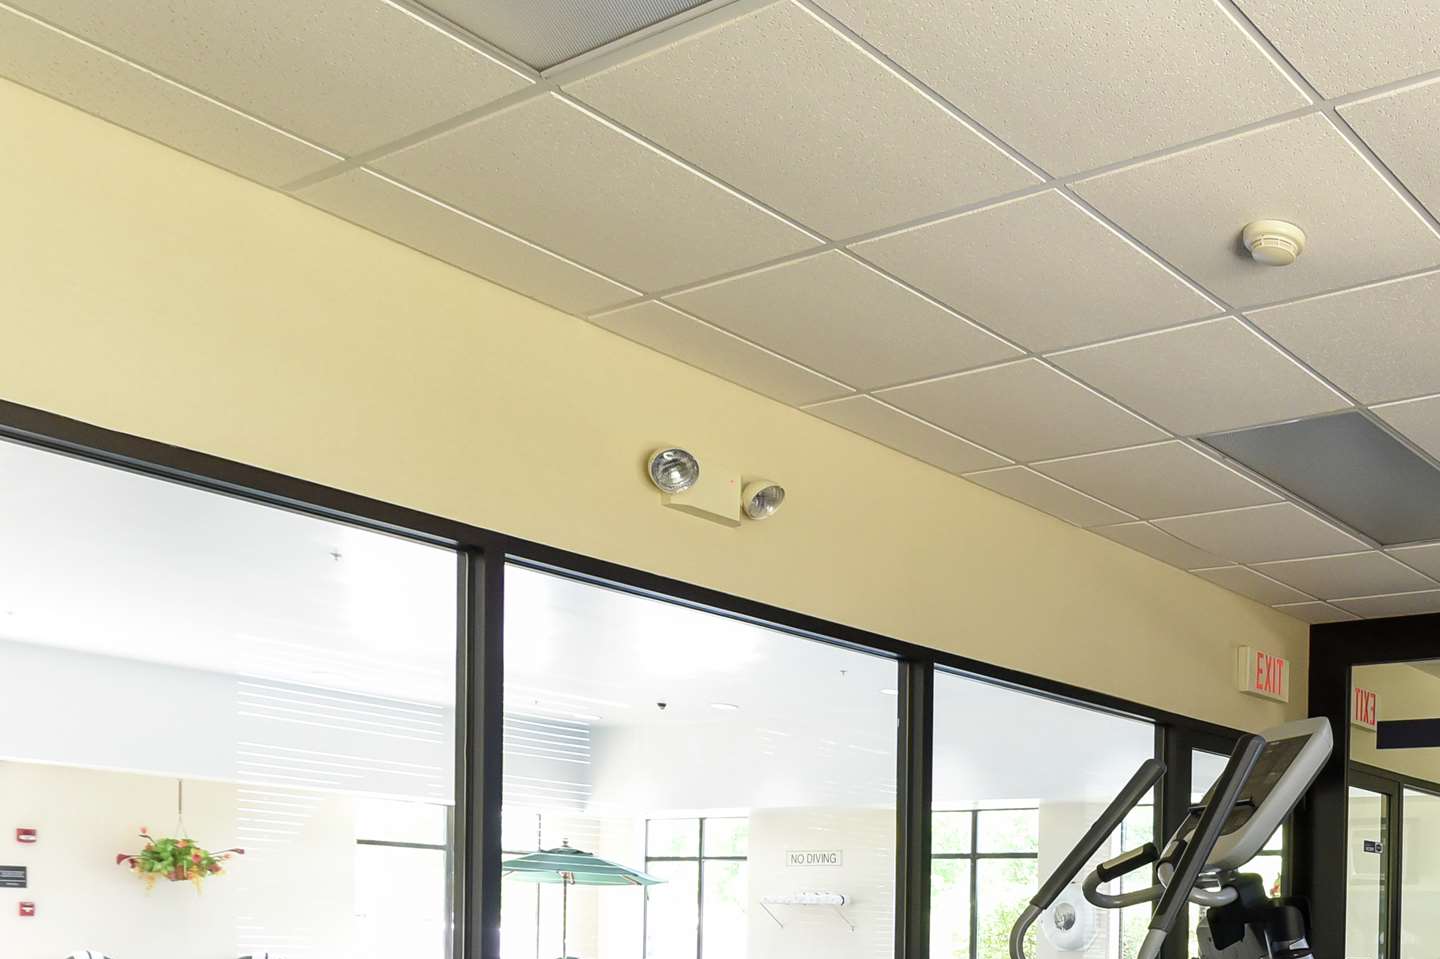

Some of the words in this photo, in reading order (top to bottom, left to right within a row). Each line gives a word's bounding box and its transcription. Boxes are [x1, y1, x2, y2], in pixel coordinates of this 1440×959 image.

[1256, 651, 1284, 695] EXIT
[790, 853, 805, 864] NO
[806, 852, 837, 864] DIVING
